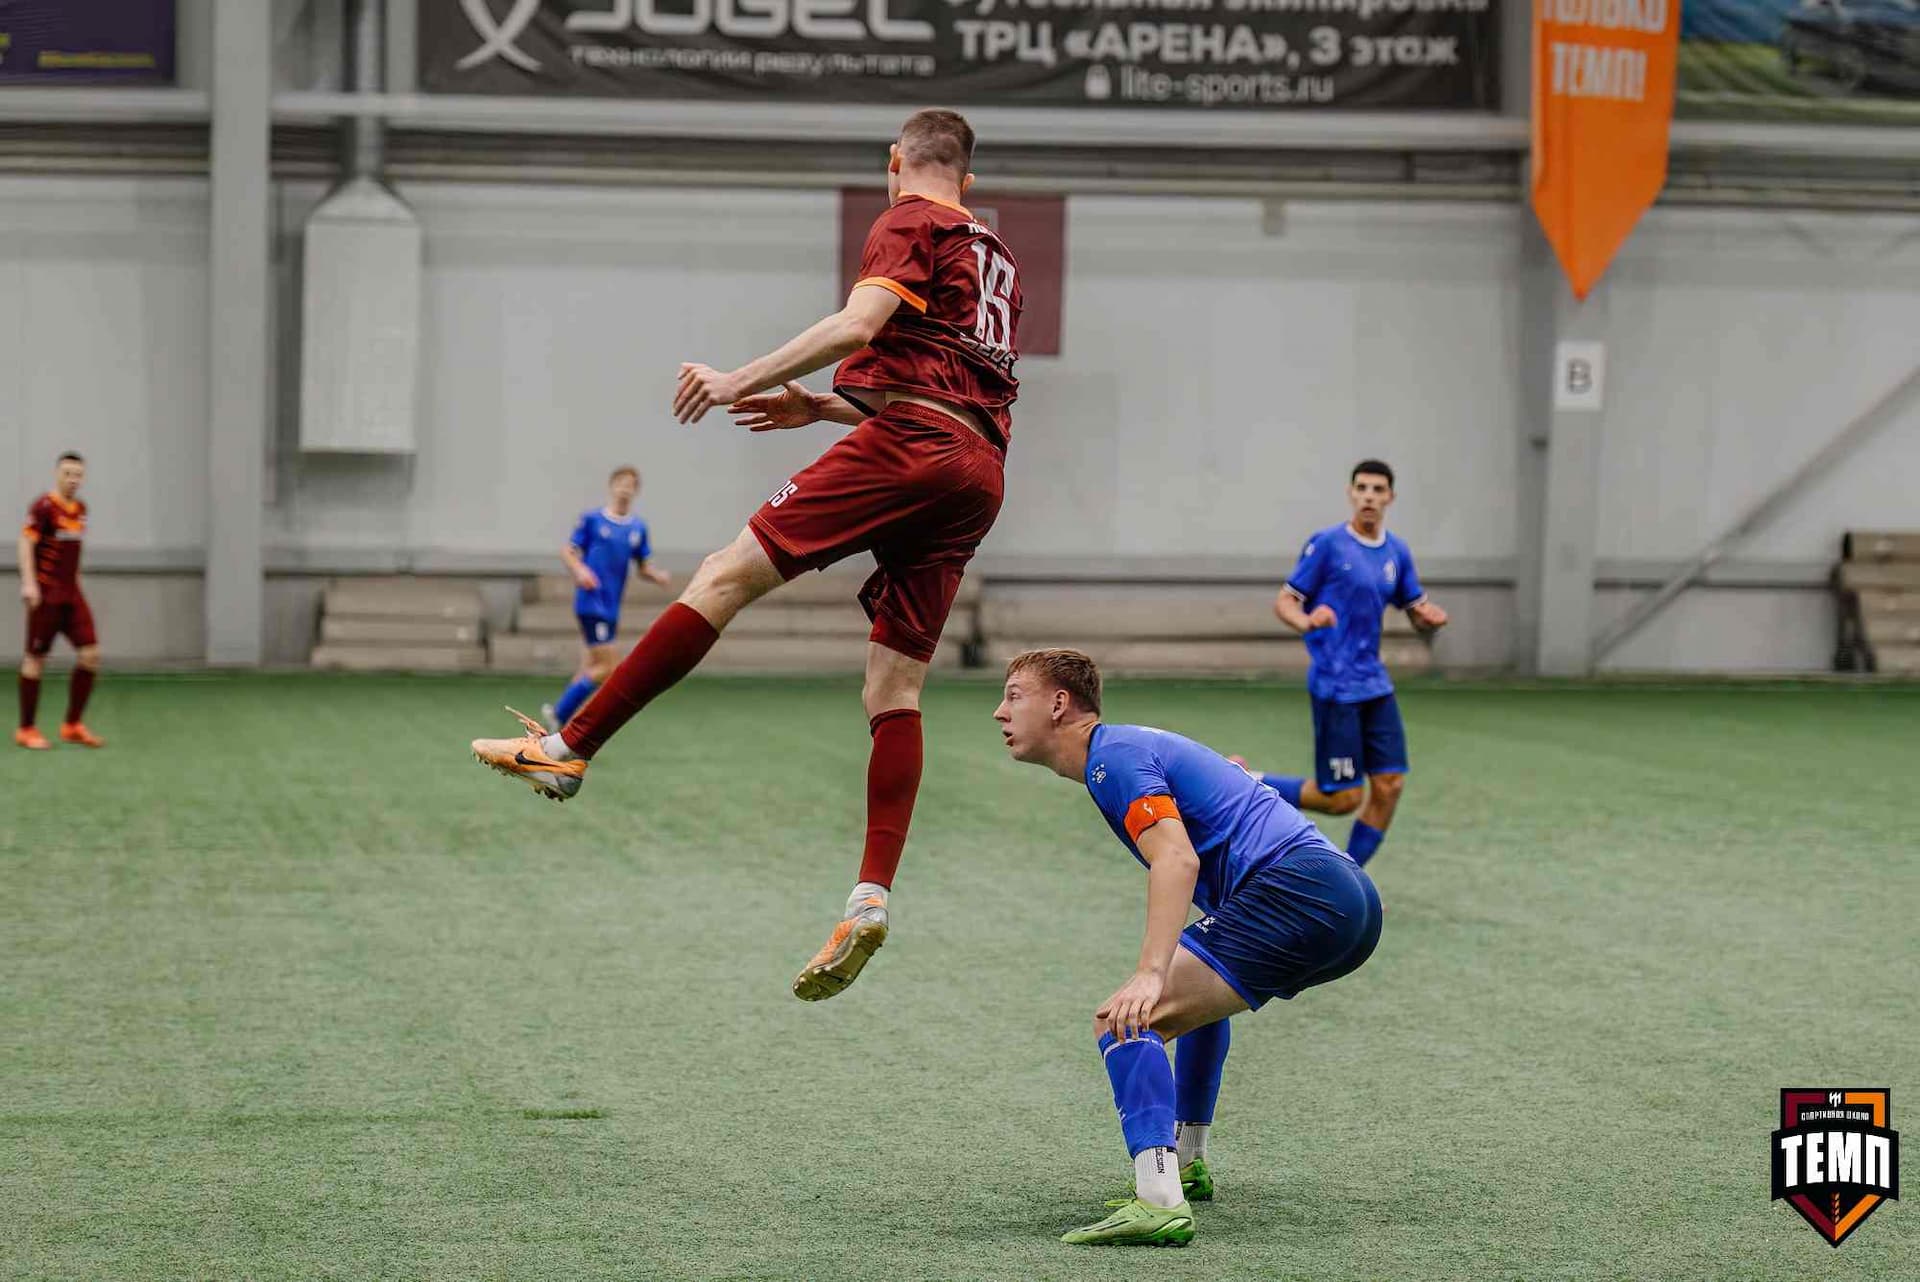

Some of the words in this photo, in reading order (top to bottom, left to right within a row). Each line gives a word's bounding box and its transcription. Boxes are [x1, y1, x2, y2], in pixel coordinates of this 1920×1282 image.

[953, 21, 1057, 67] ТРЦ
[1307, 25, 1342, 66] 3
[1351, 35, 1460, 66] этаж
[1329, 757, 1356, 780] 74
